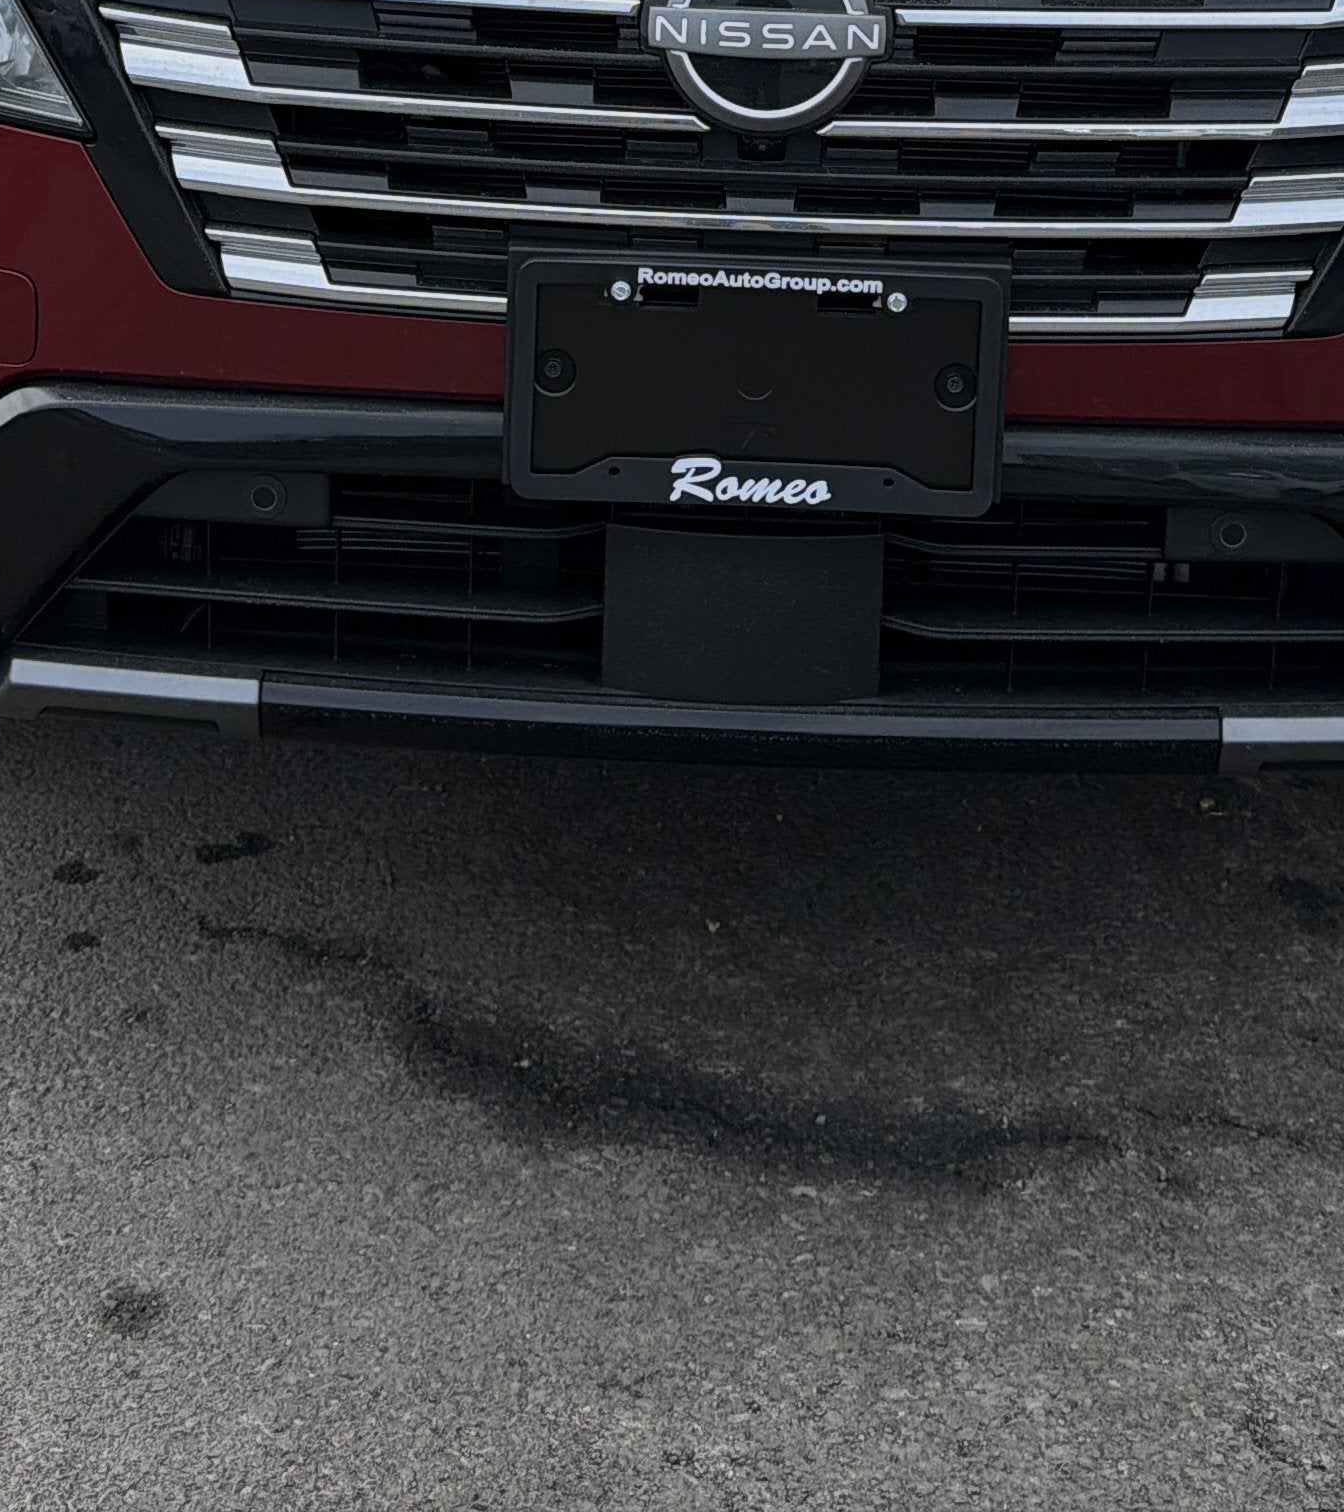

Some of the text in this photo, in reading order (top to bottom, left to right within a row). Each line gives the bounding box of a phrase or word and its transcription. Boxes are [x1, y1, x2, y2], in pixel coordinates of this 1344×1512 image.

[655, 15, 880, 50] NISSAN
[637, 267, 883, 294] RomeoAutoGroup.com
[669, 457, 832, 505] Romeo
